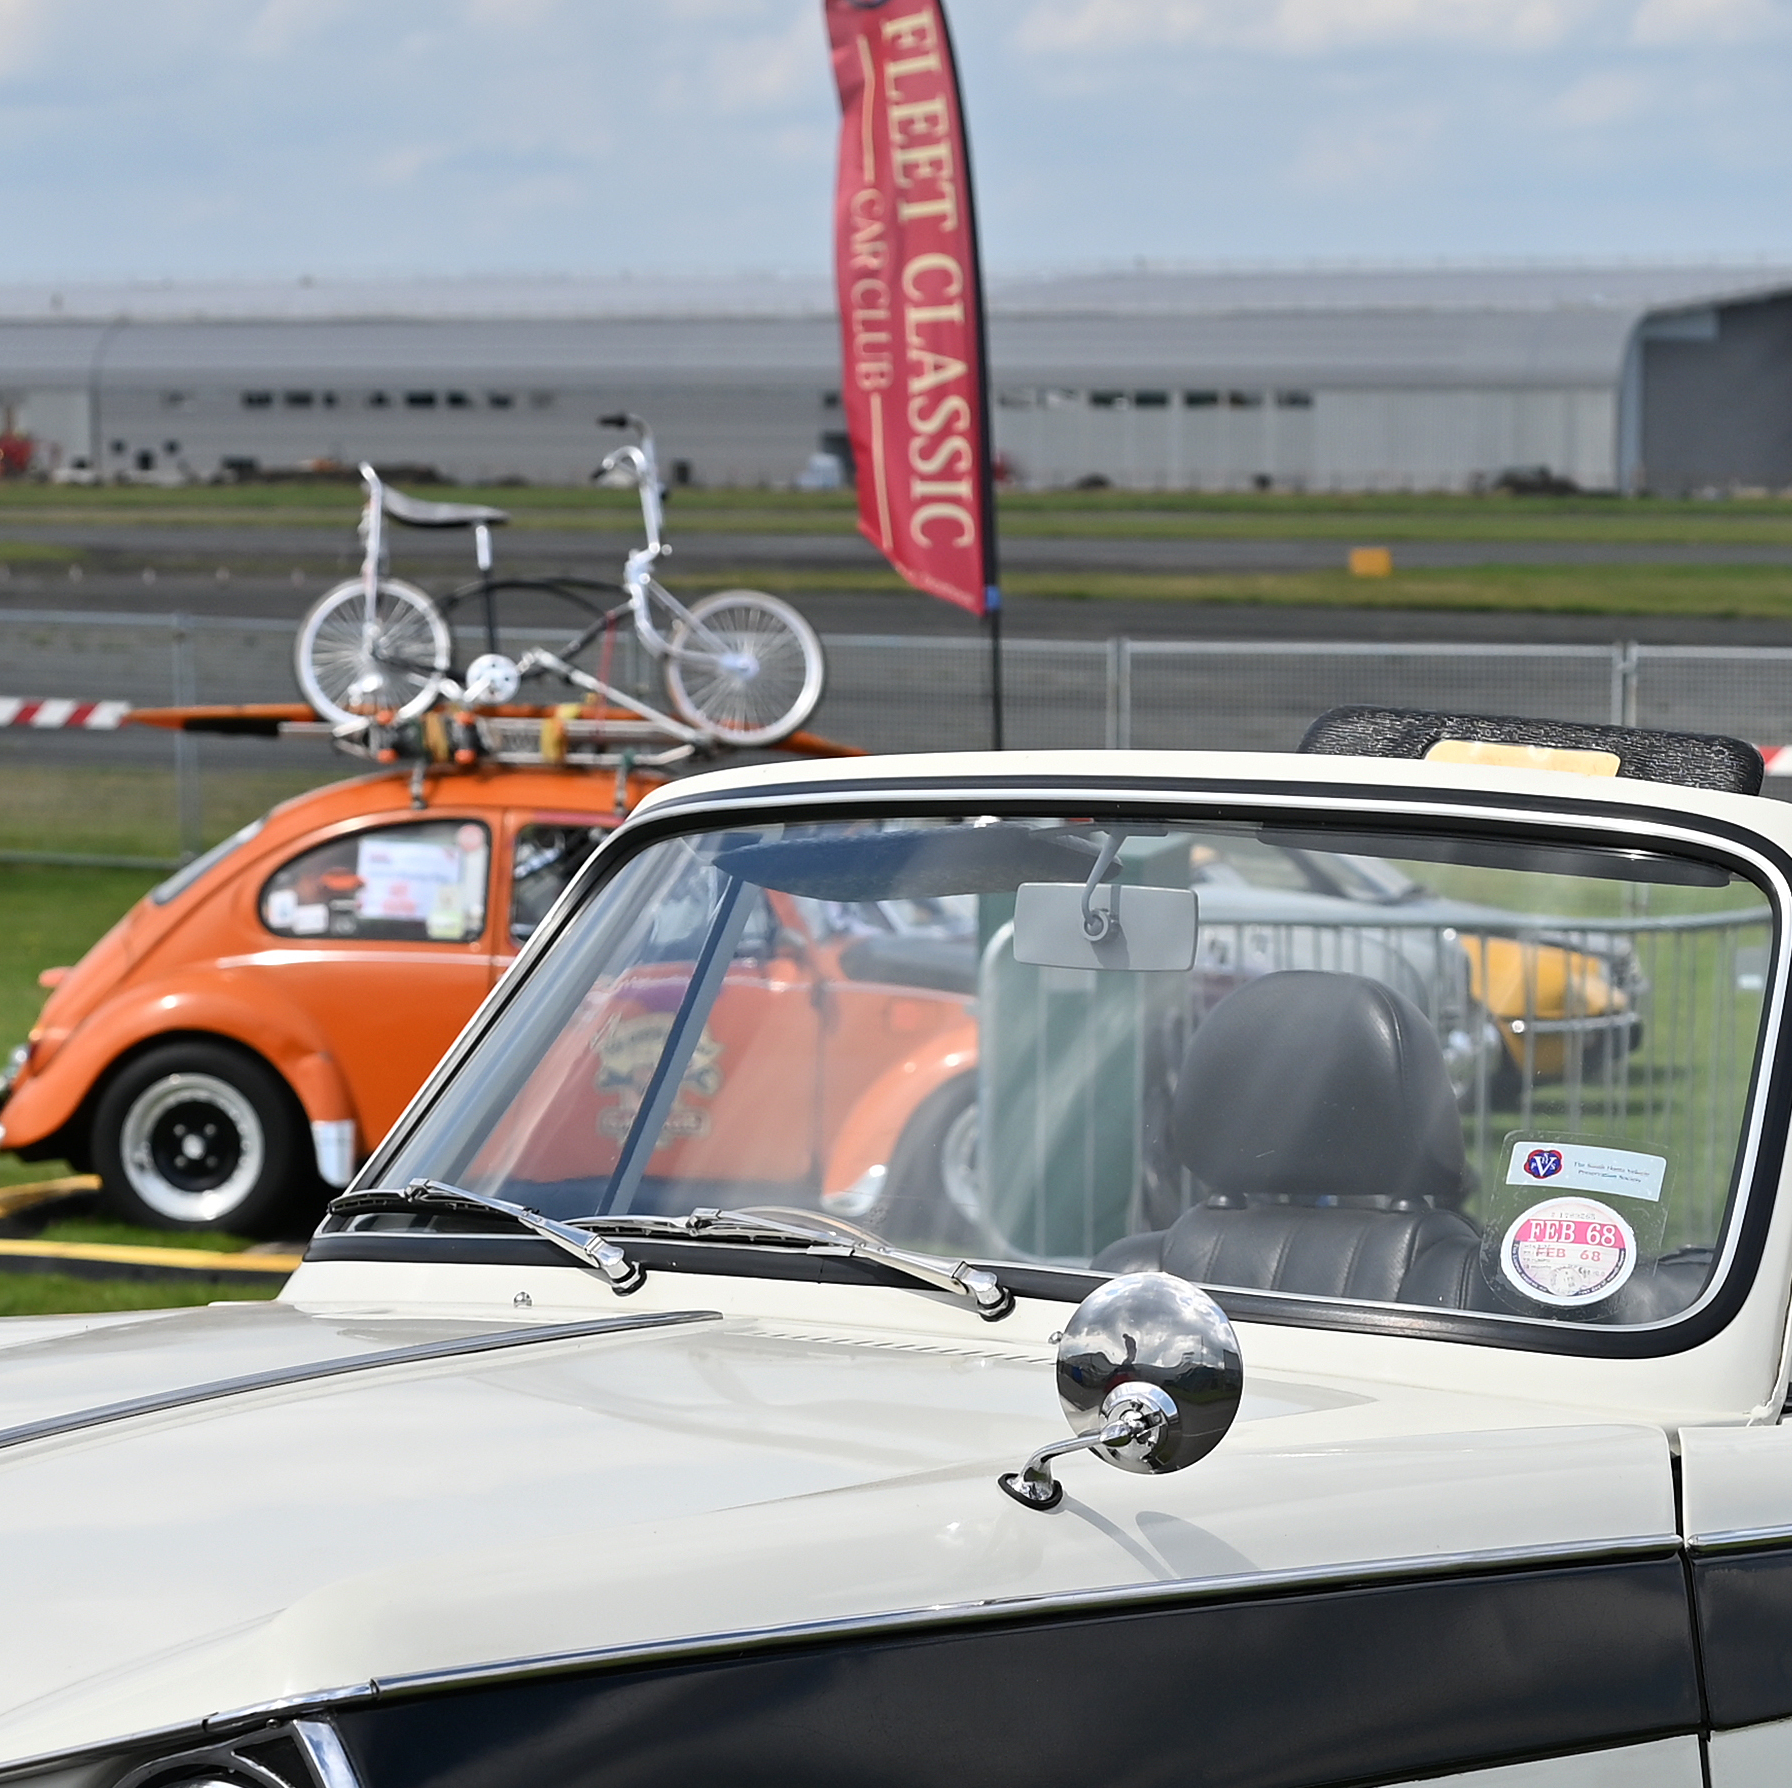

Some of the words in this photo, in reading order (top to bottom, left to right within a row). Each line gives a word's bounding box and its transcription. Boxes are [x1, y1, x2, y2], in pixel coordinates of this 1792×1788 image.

[879, 6, 957, 232] FLEET
[849, 188, 889, 270] CAR
[850, 278, 894, 392] CLUB
[901, 252, 975, 548] CLASSIC
[1528, 1220, 1576, 1243] FEB
[1586, 1223, 1616, 1247] 68
[1535, 1247, 1566, 1258] FEB
[1580, 1249, 1601, 1262] 68
